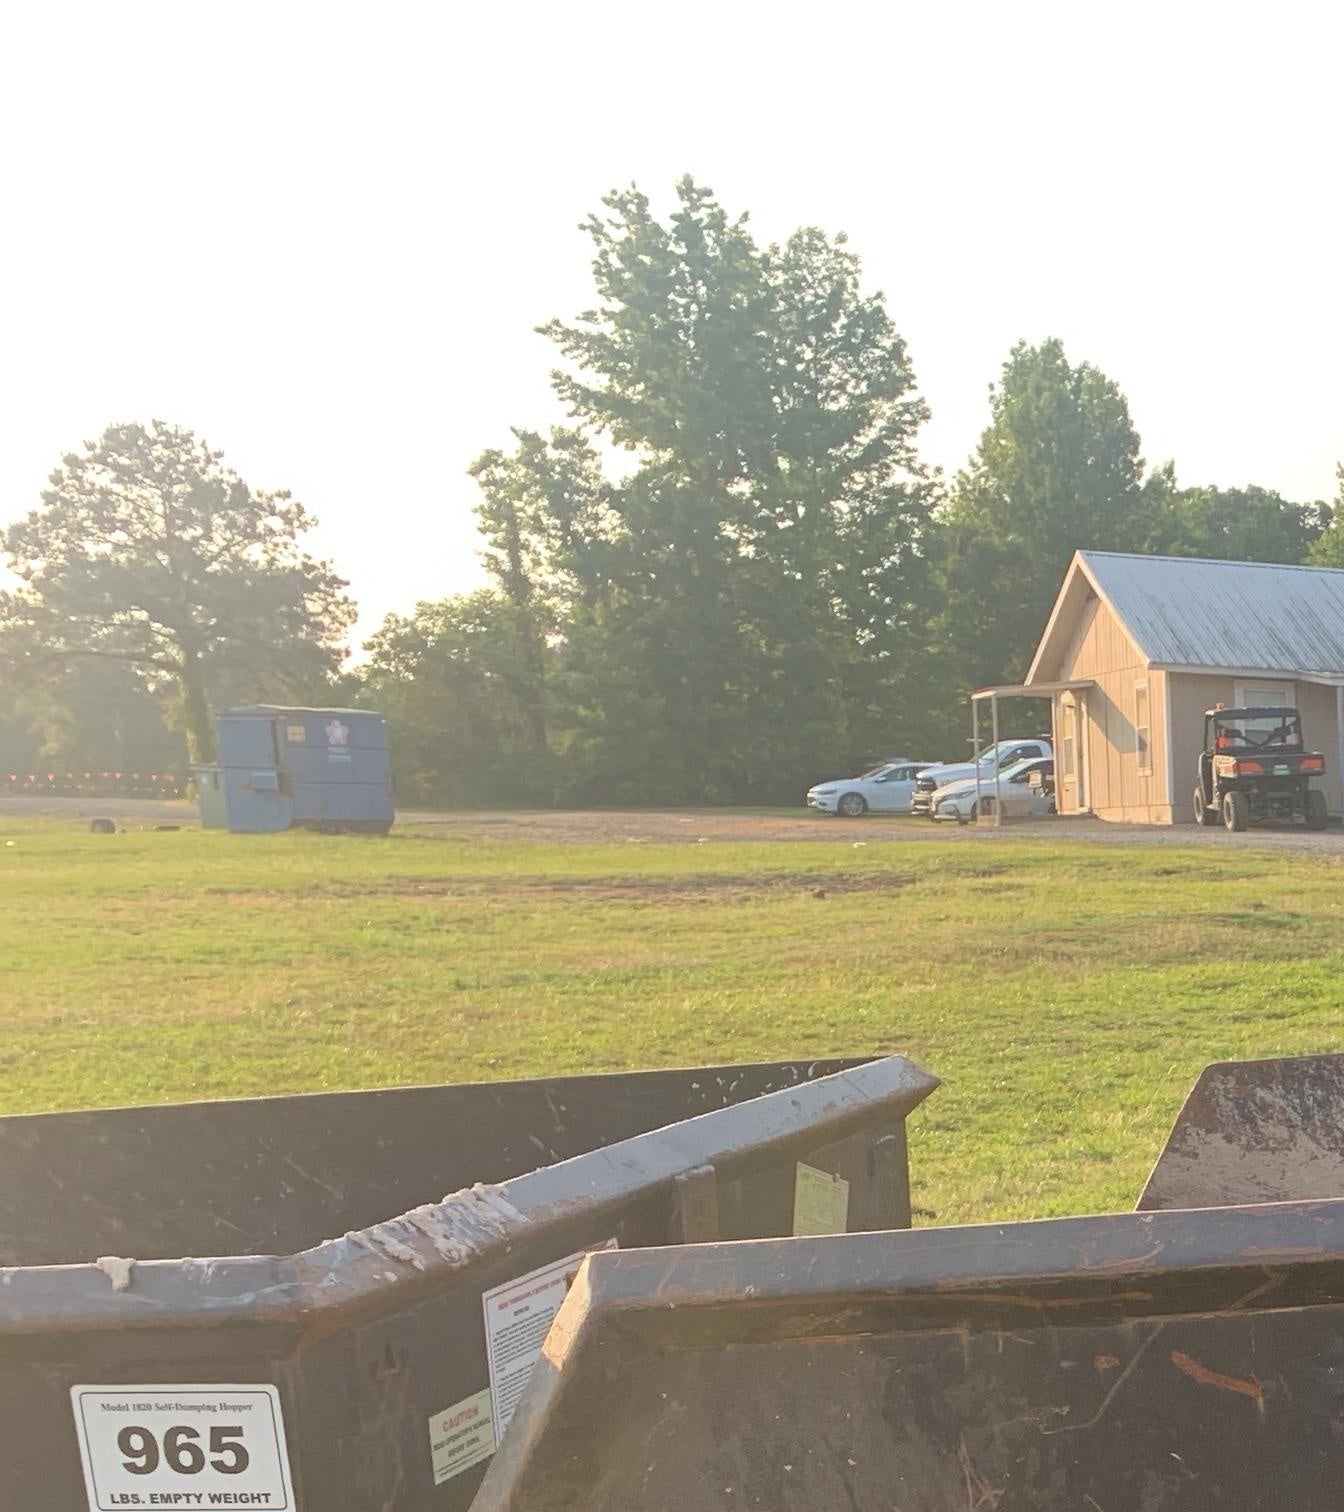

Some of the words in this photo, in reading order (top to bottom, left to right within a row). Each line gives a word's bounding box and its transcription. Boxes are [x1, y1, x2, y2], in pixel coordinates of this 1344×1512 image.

[100, 1402, 129, 1412] Model
[155, 1402, 217, 1413] Self-Dumping
[220, 1402, 253, 1413] Hopper
[117, 1425, 250, 1475] 965
[110, 1493, 146, 1504] LBS.
[151, 1493, 202, 1504] EMPTY
[207, 1492, 271, 1504] WEIGHT
